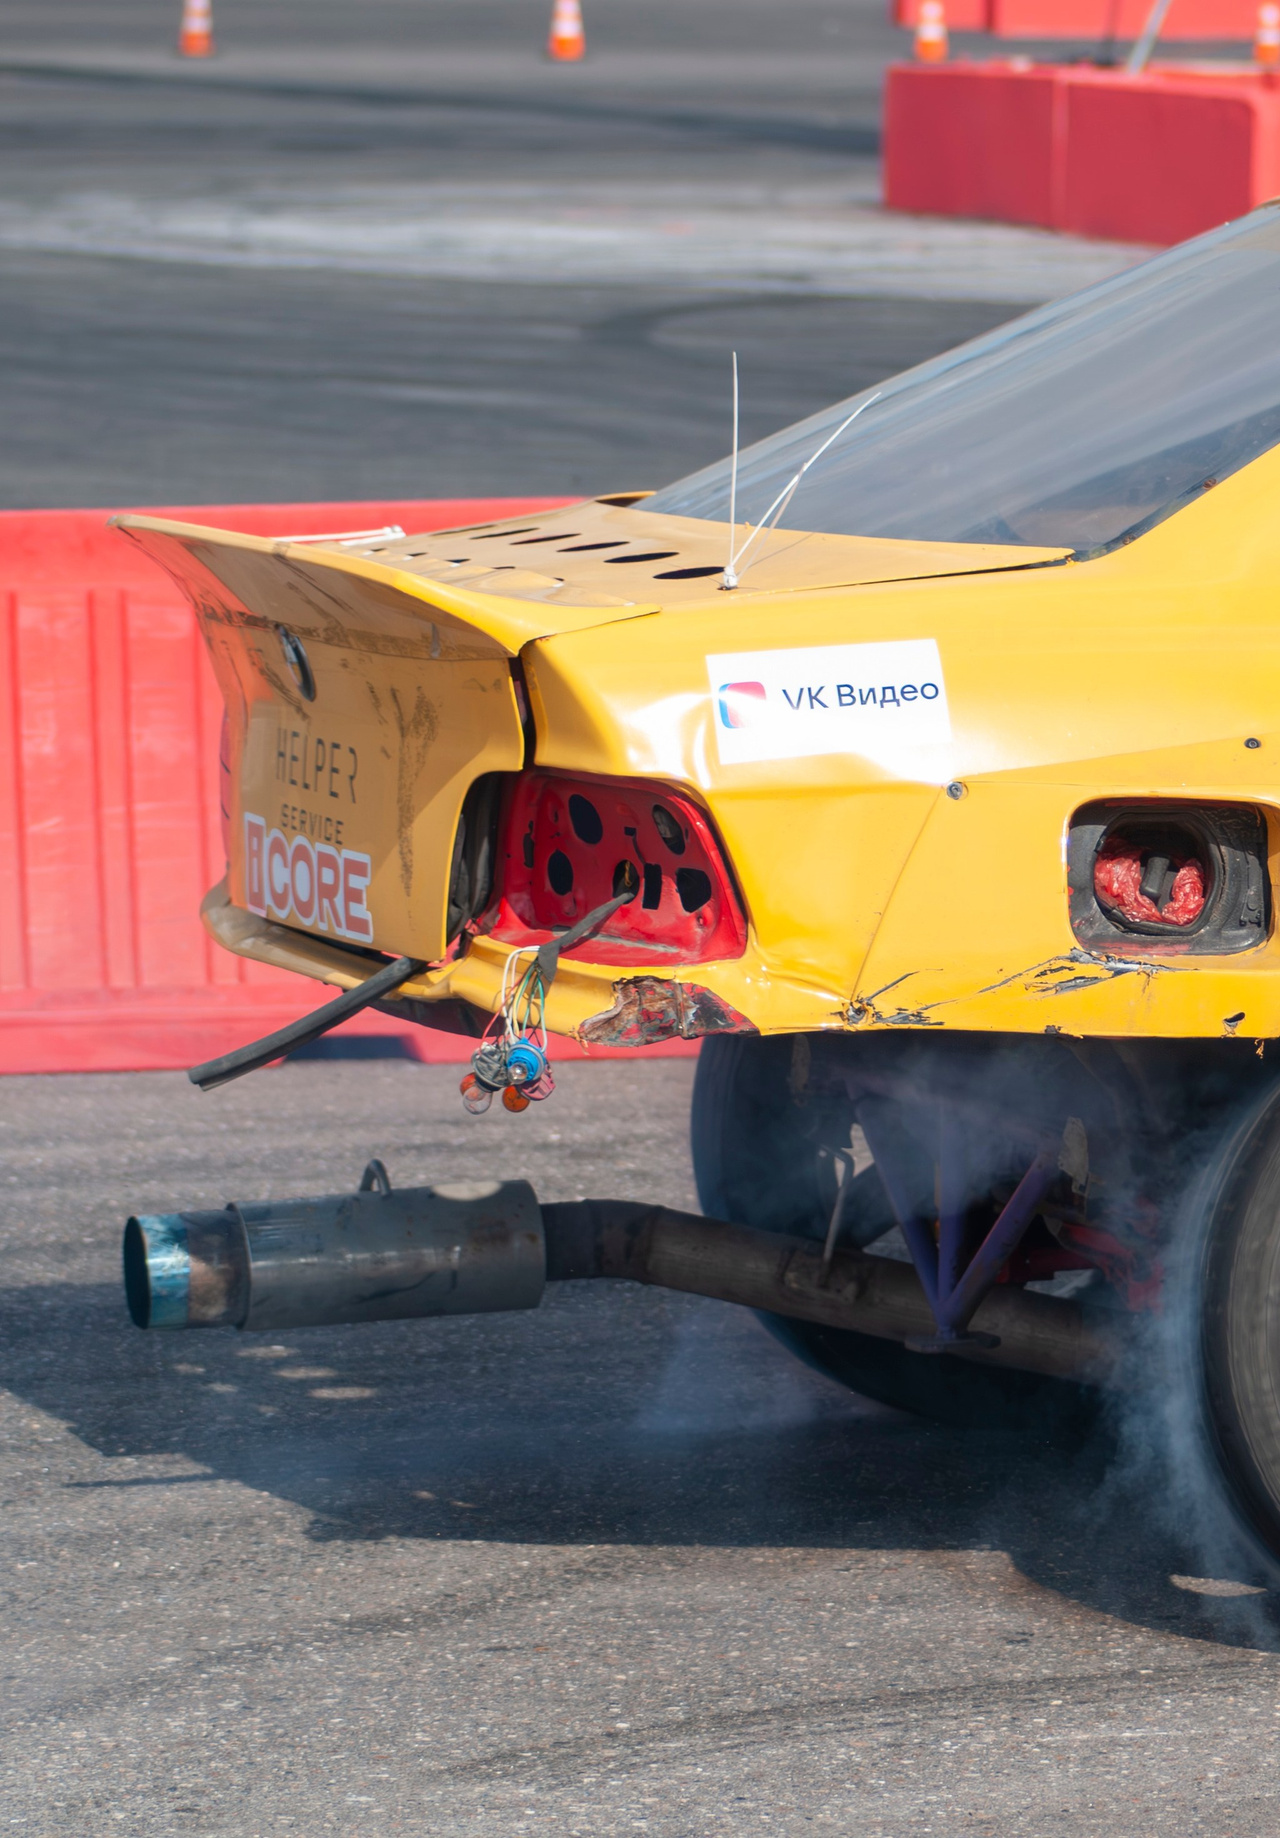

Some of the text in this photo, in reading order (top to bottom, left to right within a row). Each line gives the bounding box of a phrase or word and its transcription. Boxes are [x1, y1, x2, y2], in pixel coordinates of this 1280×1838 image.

[782, 682, 940, 710] VK Видео
[276, 728, 358, 804] HELPER
[281, 803, 344, 845] SERVICE
